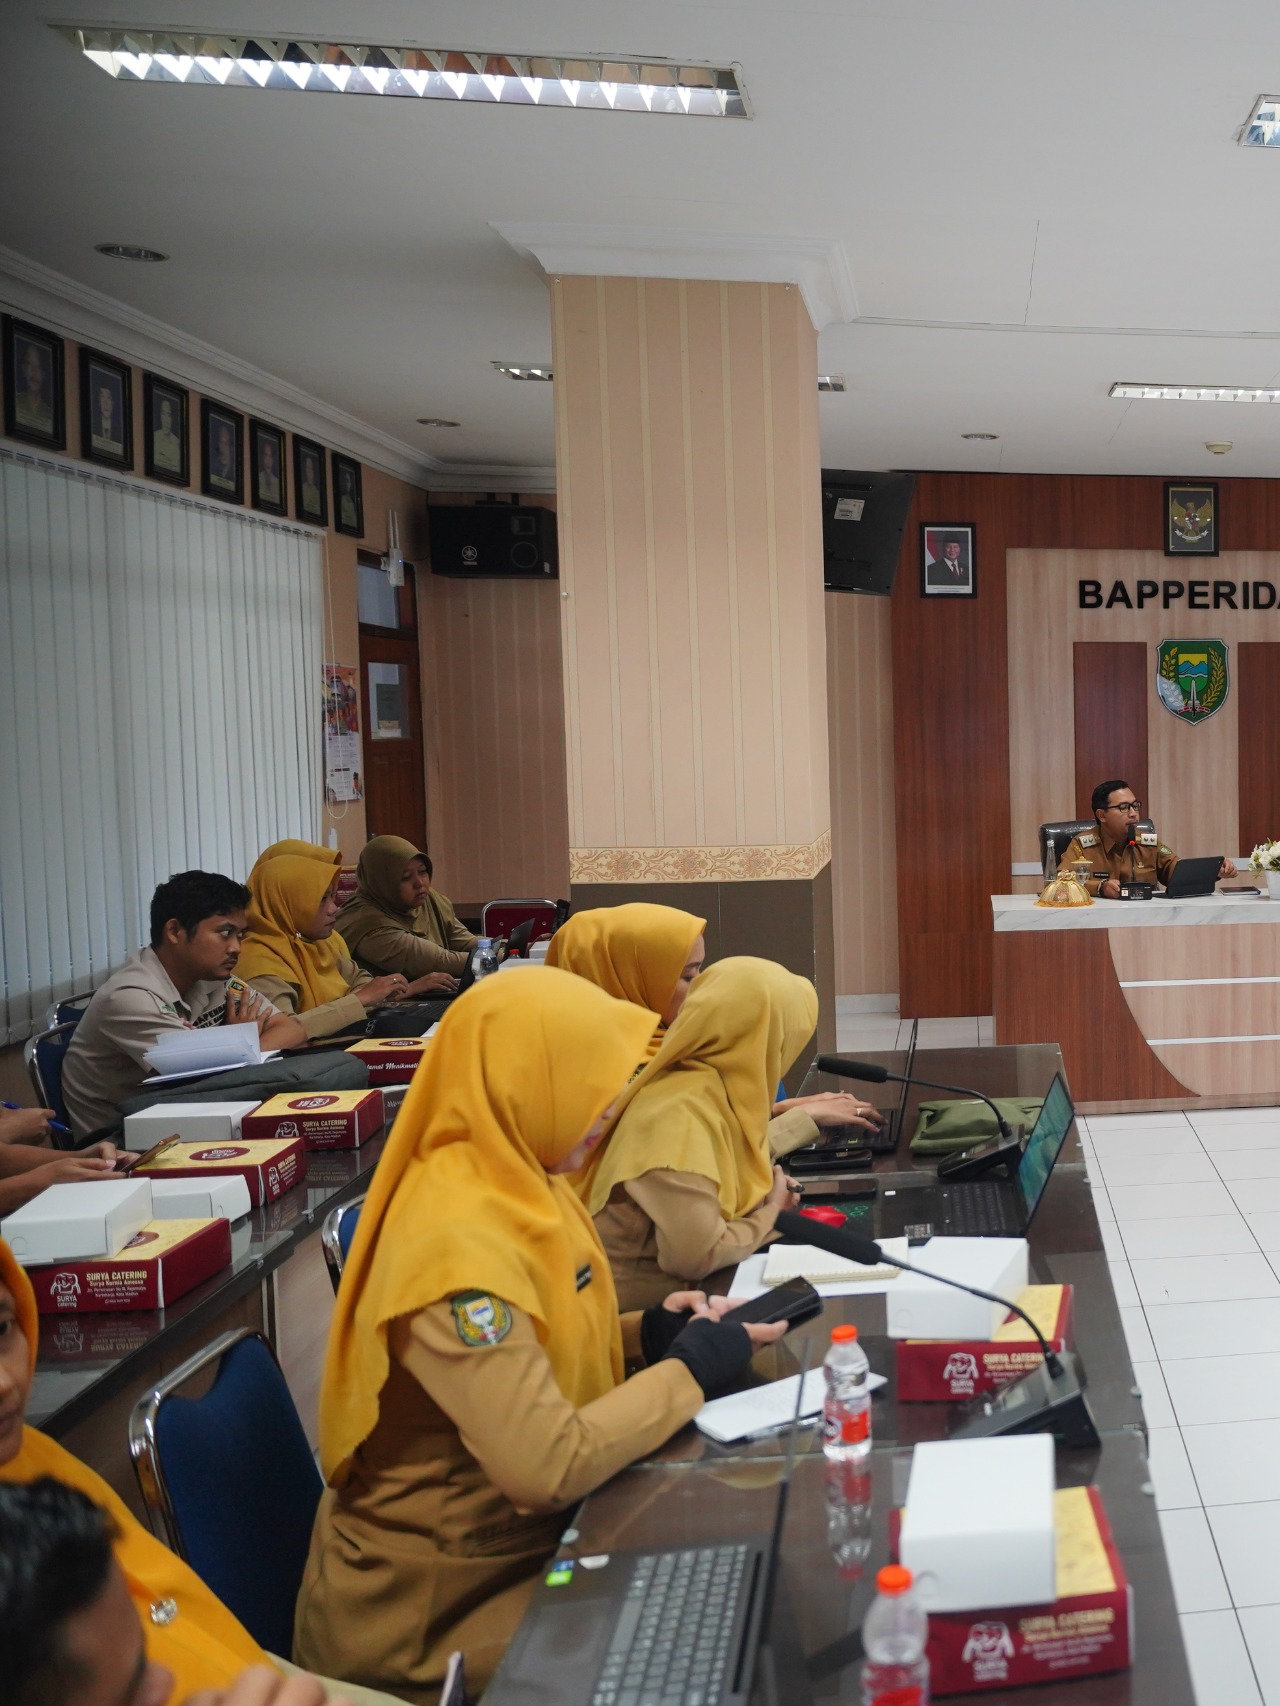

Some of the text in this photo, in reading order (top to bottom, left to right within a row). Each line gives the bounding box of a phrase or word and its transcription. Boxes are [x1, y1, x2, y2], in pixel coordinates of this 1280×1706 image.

[320, 1119, 348, 1127] CATERING
[86, 1271, 148, 1281] SURYA CATERING
